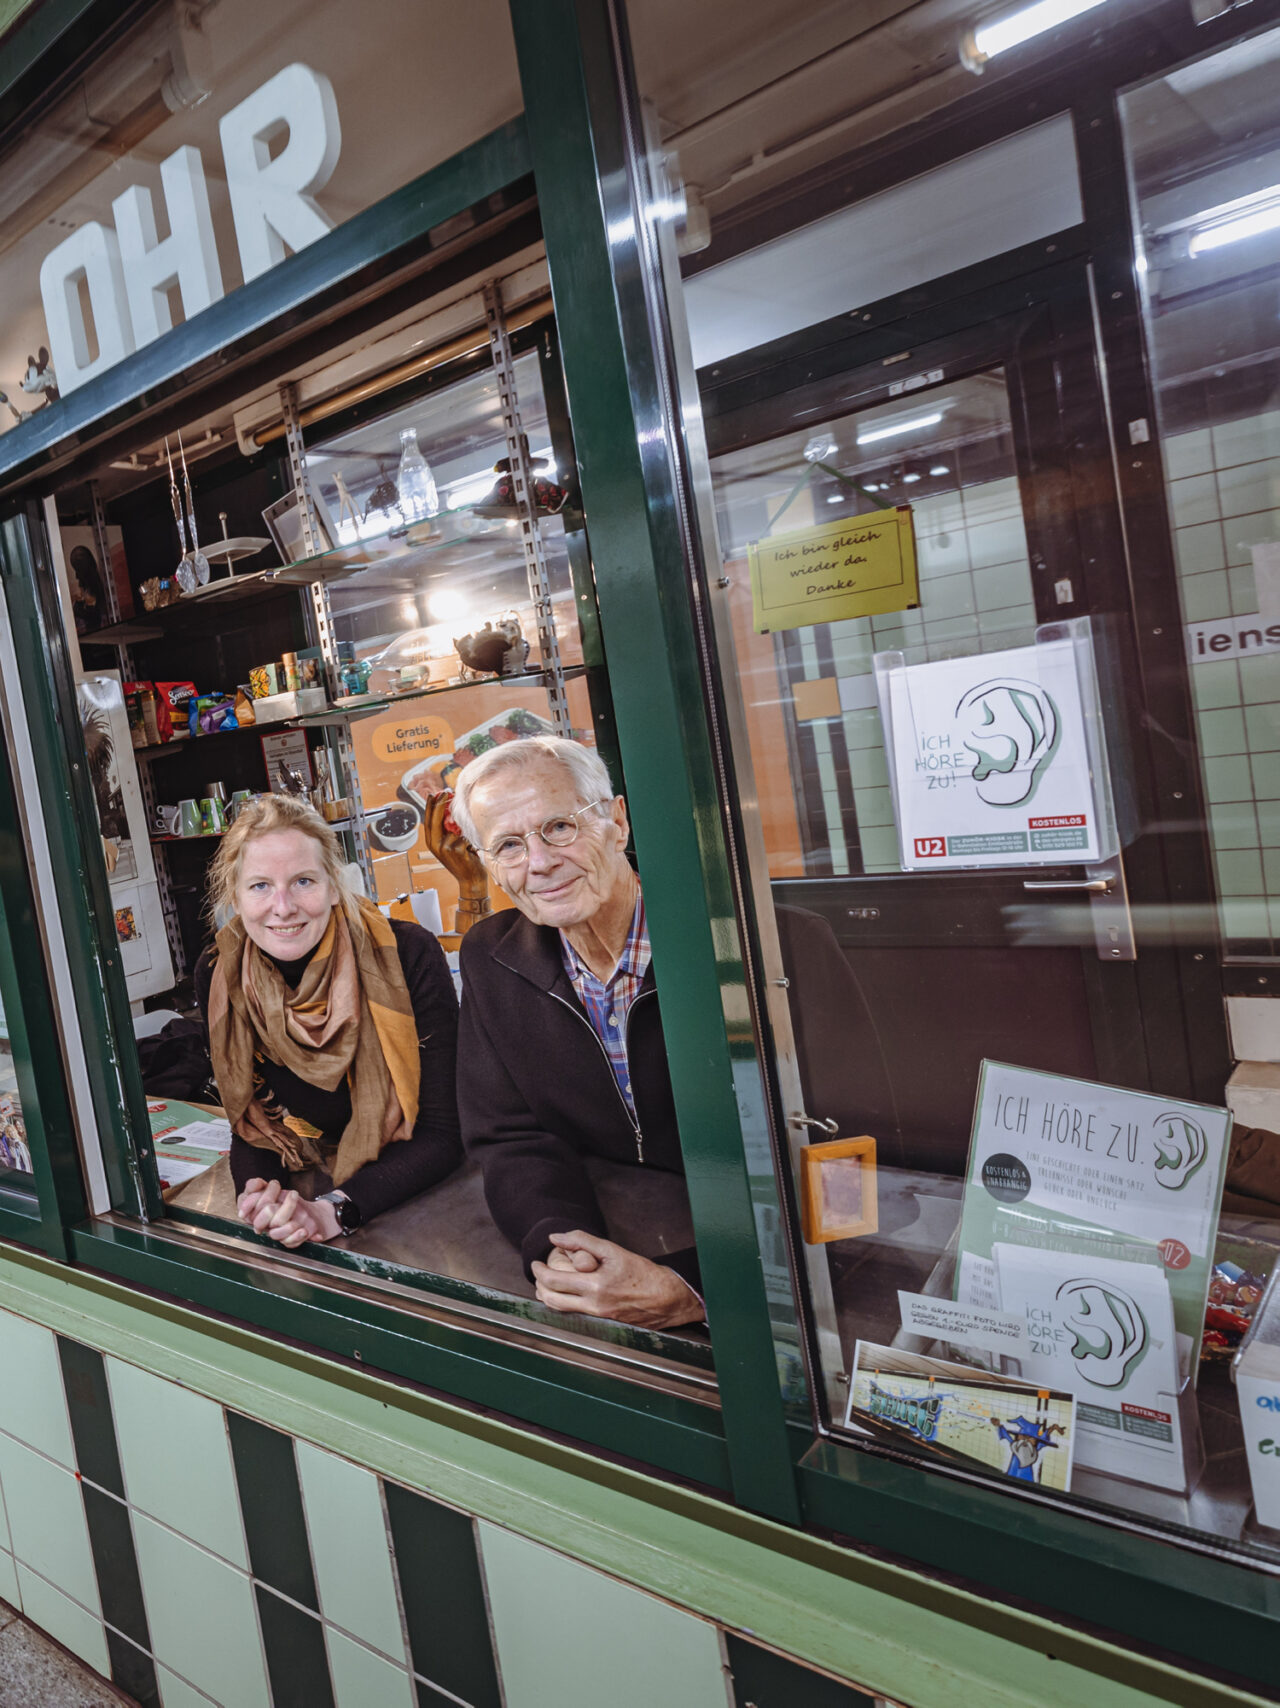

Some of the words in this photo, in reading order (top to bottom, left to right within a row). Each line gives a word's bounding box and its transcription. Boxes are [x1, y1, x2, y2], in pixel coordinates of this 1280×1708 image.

[40, 61, 342, 399] OHR
[774, 549, 798, 561] Ich
[802, 543, 831, 555] bin
[833, 531, 882, 552] gleich
[790, 560, 840, 578] wieder
[806, 579, 857, 596] Danke
[395, 724, 430, 739] Gratis
[914, 752, 966, 772] HÖRE
[925, 770, 957, 790] ZU!
[1032, 817, 1082, 828] KOSTENLOS
[916, 839, 943, 856] U2
[994, 1093, 1030, 1135] ICH
[1041, 1102, 1097, 1152] HÖRE
[1106, 1122, 1144, 1165] ZU.
[985, 1165, 1020, 1179] KOSTENLOS
[911, 1303, 928, 1311] DAS
[974, 1315, 996, 1326] FOTO
[1030, 1340, 1059, 1358] ZU!
